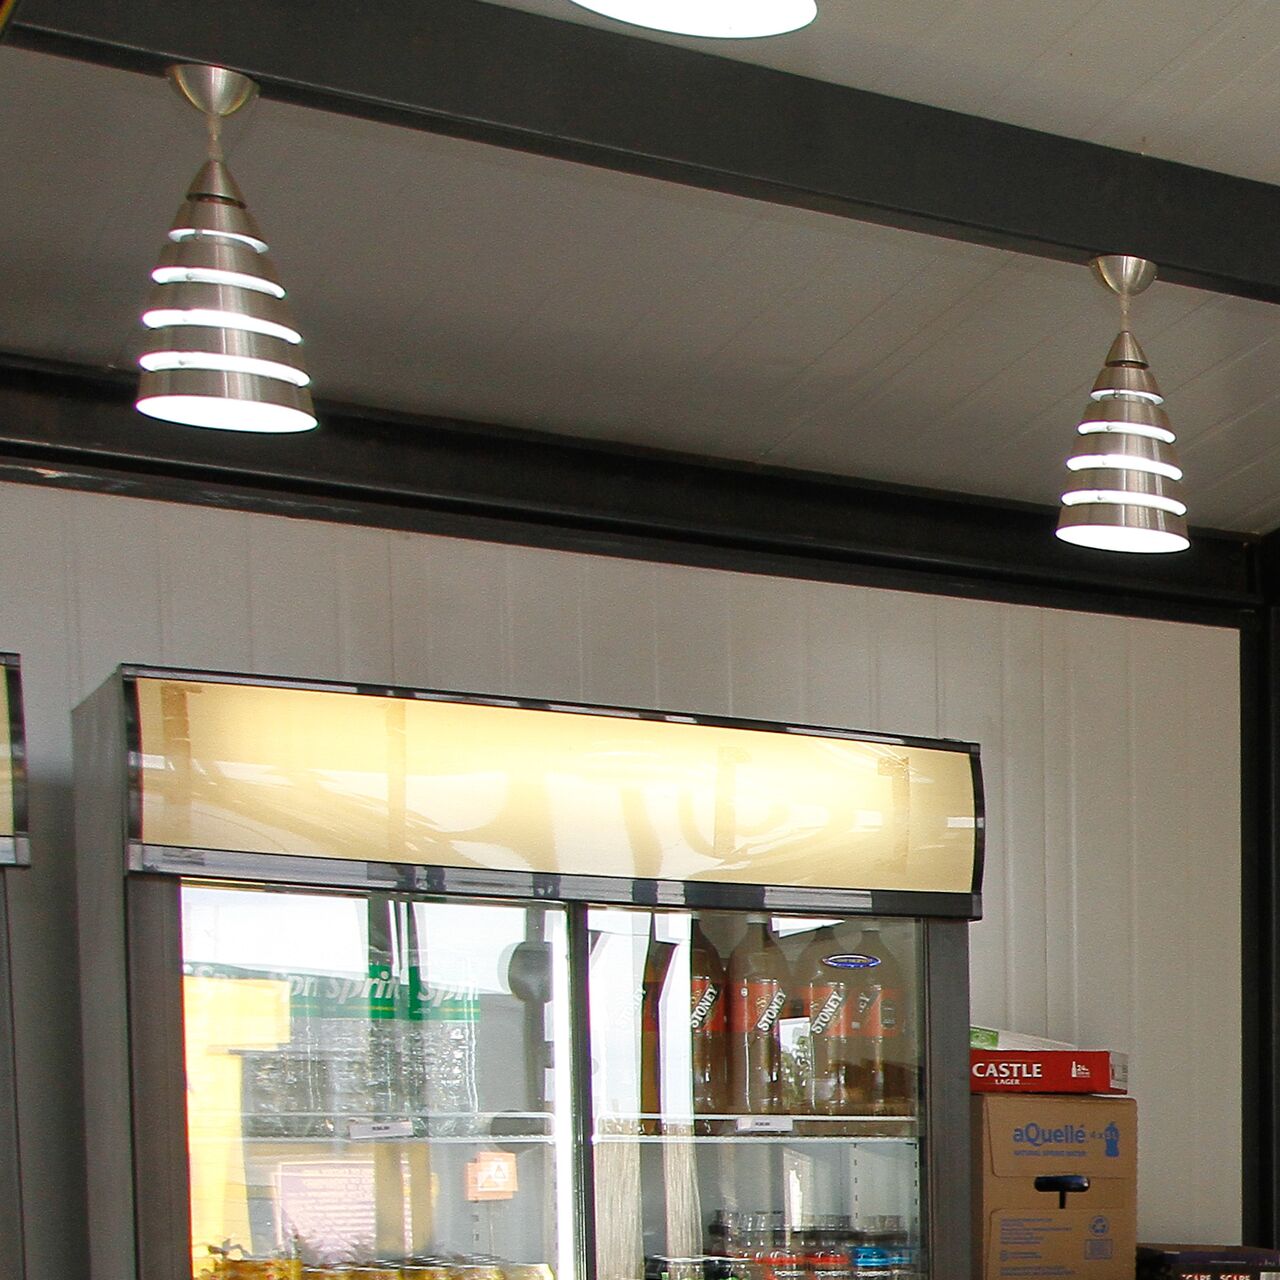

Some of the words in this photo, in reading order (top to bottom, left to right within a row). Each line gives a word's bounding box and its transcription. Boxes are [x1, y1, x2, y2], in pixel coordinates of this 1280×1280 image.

[757, 989, 788, 1032] STONEY
[811, 989, 845, 1034] STONEY
[972, 1063, 1042, 1078] CASTLE
[1013, 1122, 1086, 1146] aQuellé
